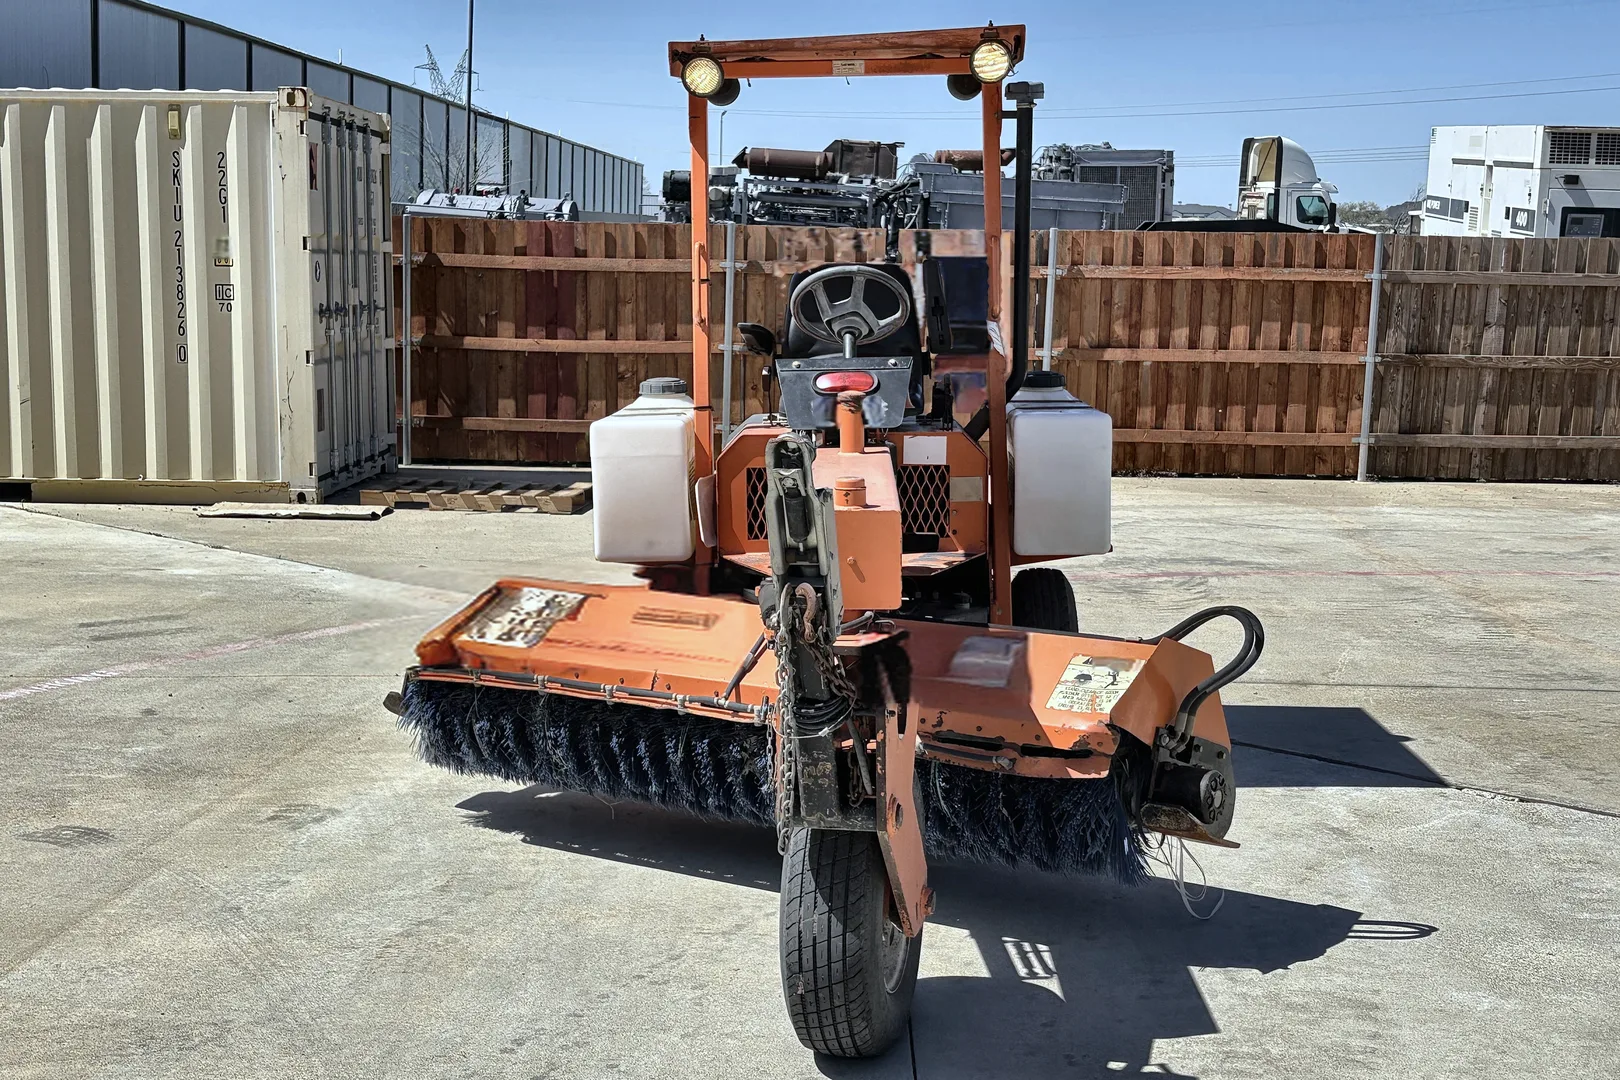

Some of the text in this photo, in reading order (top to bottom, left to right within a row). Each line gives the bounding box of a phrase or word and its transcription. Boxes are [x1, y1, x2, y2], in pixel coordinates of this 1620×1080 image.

[217, 151, 227, 224] 22G1
[172, 150, 187, 362] SKIU 213826 0
[218, 302, 232, 313] 70
